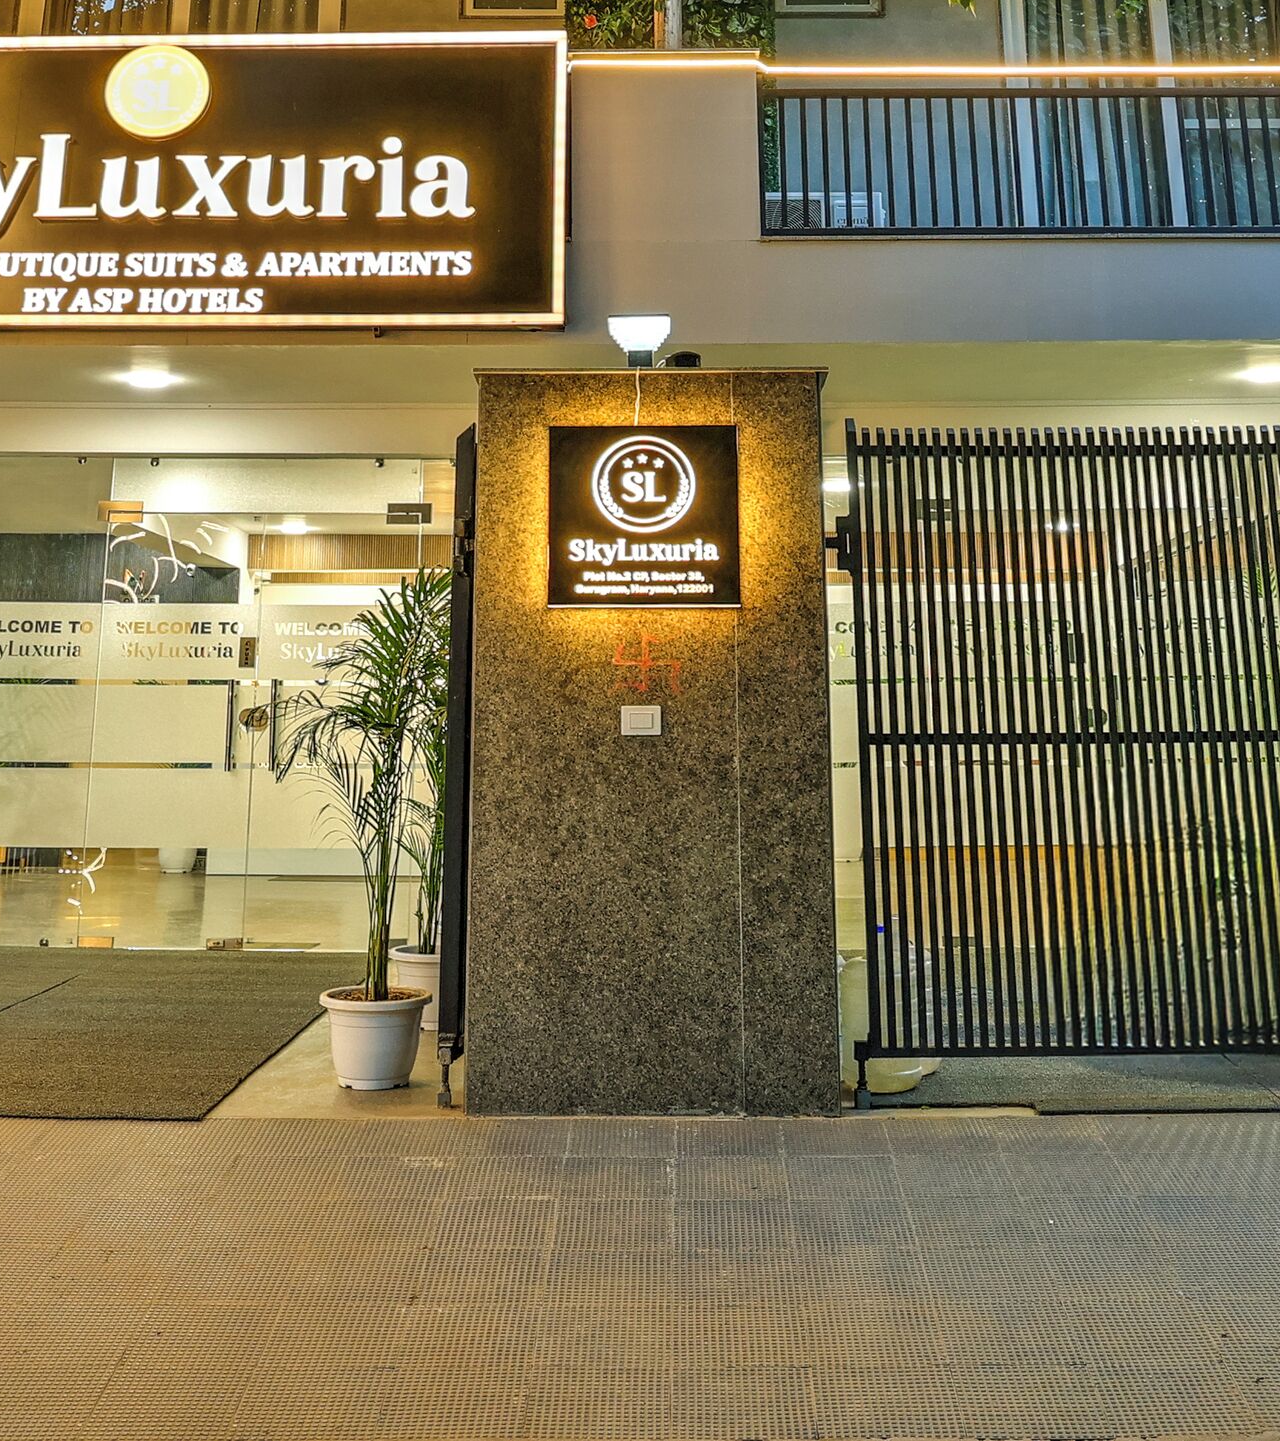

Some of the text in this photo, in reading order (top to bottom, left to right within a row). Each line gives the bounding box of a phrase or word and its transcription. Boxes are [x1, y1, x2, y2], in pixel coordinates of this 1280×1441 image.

[132, 79, 180, 113] SL
[123, 252, 217, 277] SUITS
[221, 252, 249, 277] &
[255, 251, 473, 277] APARTMENTS
[21, 287, 265, 313] BY ASP HOTELS
[621, 471, 667, 502] SL
[568, 538, 720, 567] SkyLuxuria
[68, 620, 94, 634] TO
[116, 620, 243, 635] WELCOME TO
[121, 641, 233, 661] SkyLuxuria
